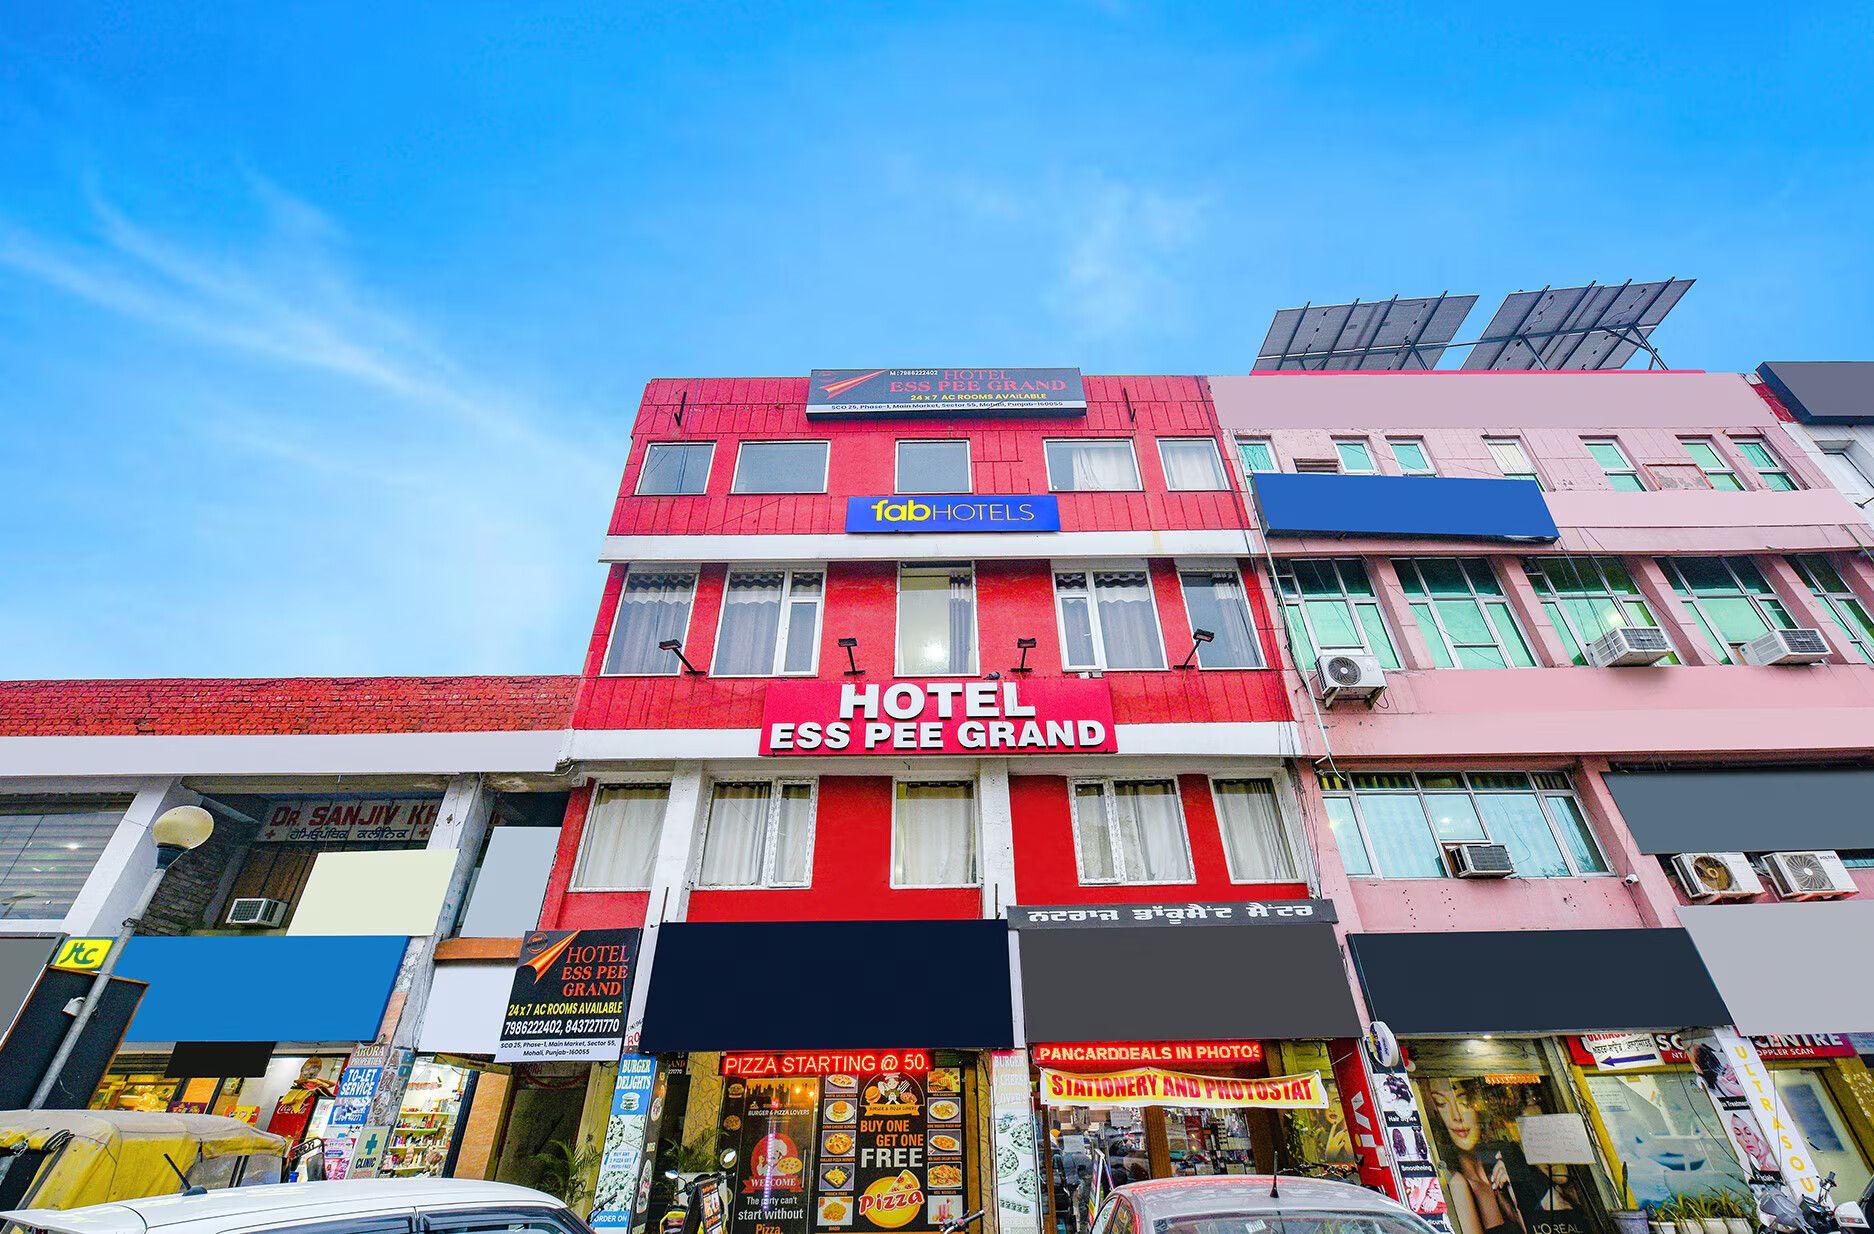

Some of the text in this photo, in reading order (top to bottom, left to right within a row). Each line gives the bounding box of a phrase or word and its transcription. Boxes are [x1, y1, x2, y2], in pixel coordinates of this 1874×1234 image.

[943, 369, 1011, 381] HOTEL
[889, 379, 1067, 392] ESS PEE GRAND
[839, 681, 1037, 720] HOTEL
[769, 719, 1106, 750] ESS PEE GRAND
[308, 804, 402, 827] SANJIV
[1027, 909, 1120, 923] ਨਟਰਾਜ
[1245, 902, 1314, 918] ਸੈਂਟਰ
[566, 945, 630, 964] HOTEL
[561, 965, 628, 981] ESS PEE
[562, 981, 622, 997] GRAND
[508, 1001, 623, 1016] 24 x 7 AC ROOMS AVAILABLE
[504, 1019, 563, 1036] 7986222402,
[565, 1018, 620, 1034] 8437271770
[545, 1048, 590, 1057] Punjab-160055
[1176, 1046, 1192, 1060] IN
[1756, 1048, 1788, 1056] OPPLER
[621, 1058, 651, 1074] BURGER
[725, 1053, 930, 1075] PIZZA STARTING @ 50.
[994, 1056, 1025, 1068] BURGER
[347, 1068, 378, 1082] TO-LET
[616, 1074, 652, 1090] DELIGHTS
[339, 1081, 376, 1096] SERVICE
[1051, 1073, 1313, 1101] STATIONERY AND PHOTOSTAT
[860, 1120, 910, 1132] BUY ONE
[876, 1134, 924, 1147] GET ONE
[355, 1157, 377, 1169] CLINIC
[860, 1148, 924, 1168] FREE
[752, 1178, 796, 1187] WECOME
[747, 1196, 760, 1205] The
[780, 1196, 798, 1204] can't
[859, 1189, 925, 1216] Pizza
[738, 1207, 804, 1221] start without
